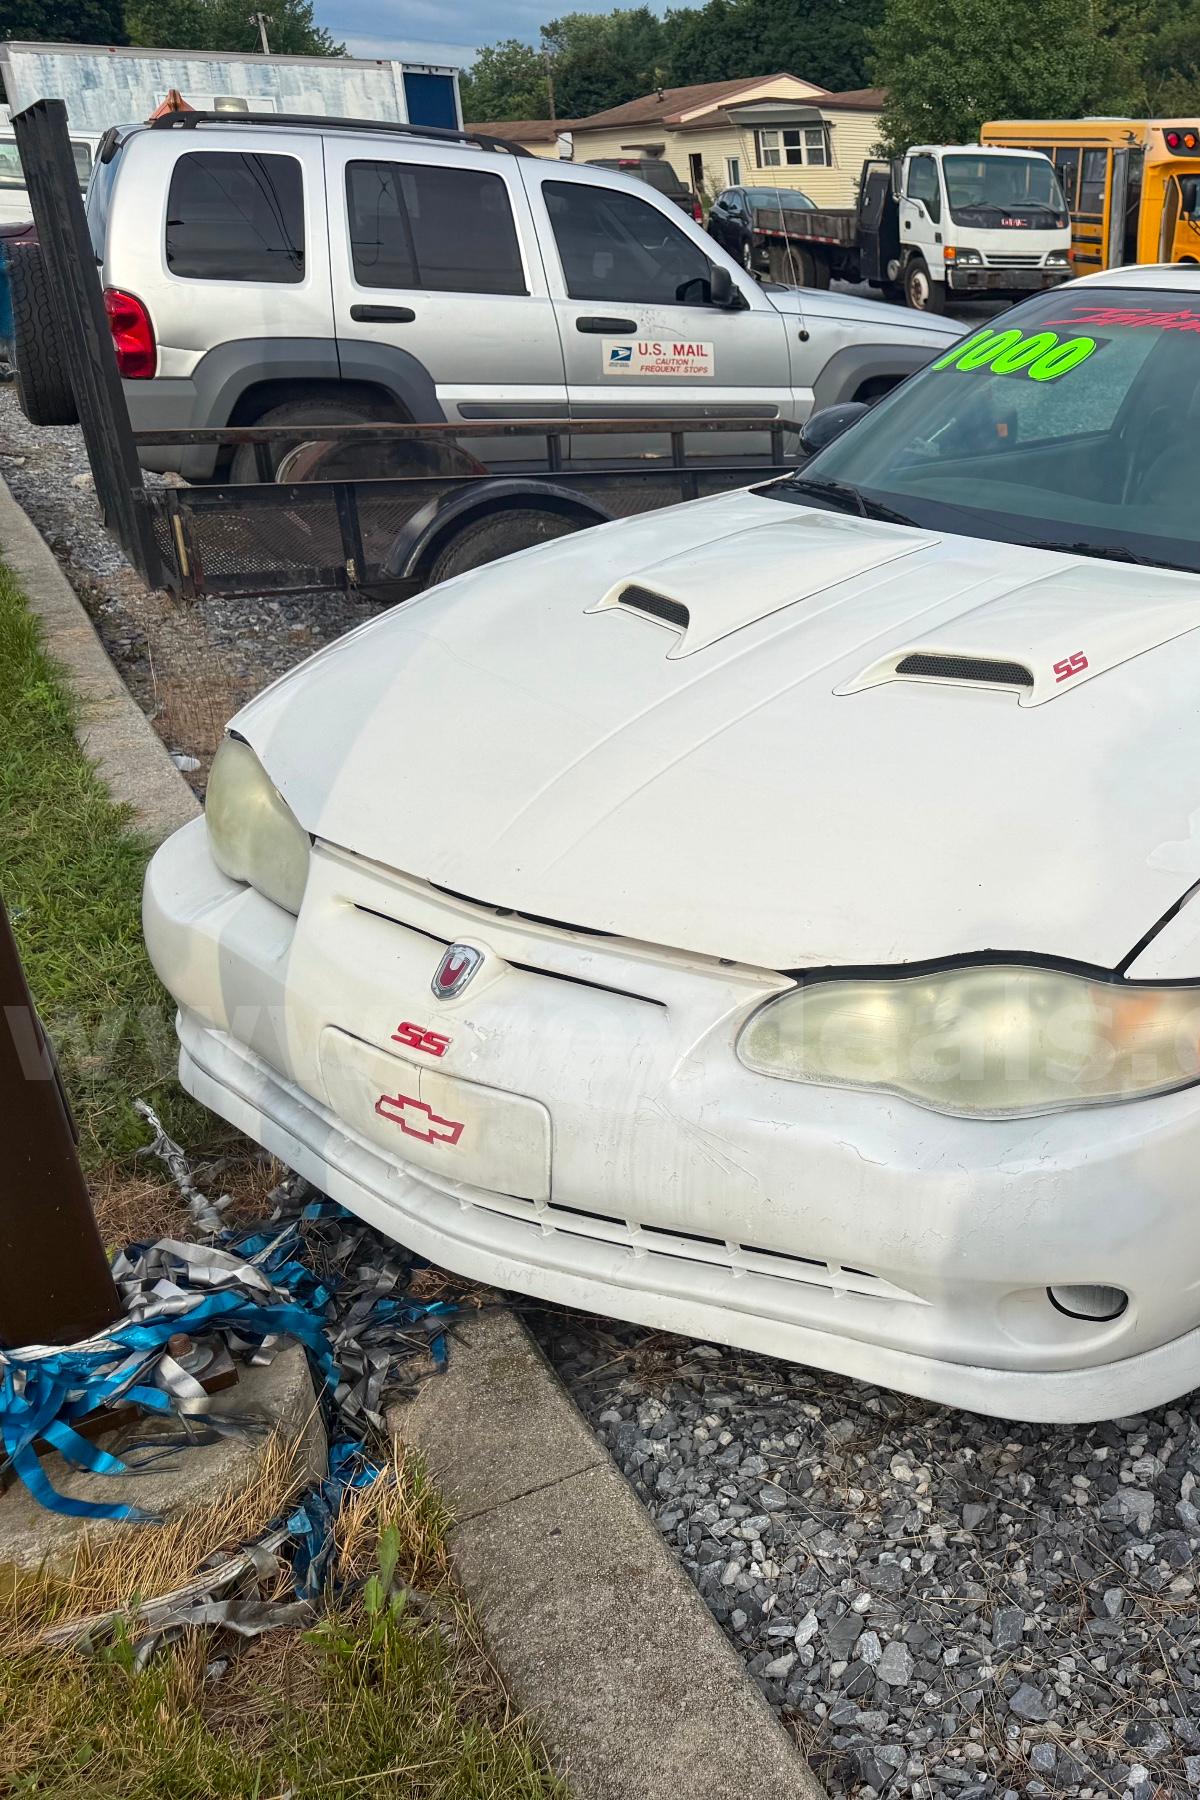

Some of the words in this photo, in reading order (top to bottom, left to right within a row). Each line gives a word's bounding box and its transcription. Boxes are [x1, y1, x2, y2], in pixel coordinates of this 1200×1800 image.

[638, 342, 667, 356] U.S.
[673, 344, 708, 357] MAIL
[931, 329, 1097, 381] 1000
[640, 365, 680, 373] FREQUENT
[1053, 651, 1088, 683] SS
[391, 1021, 453, 1057] SS
